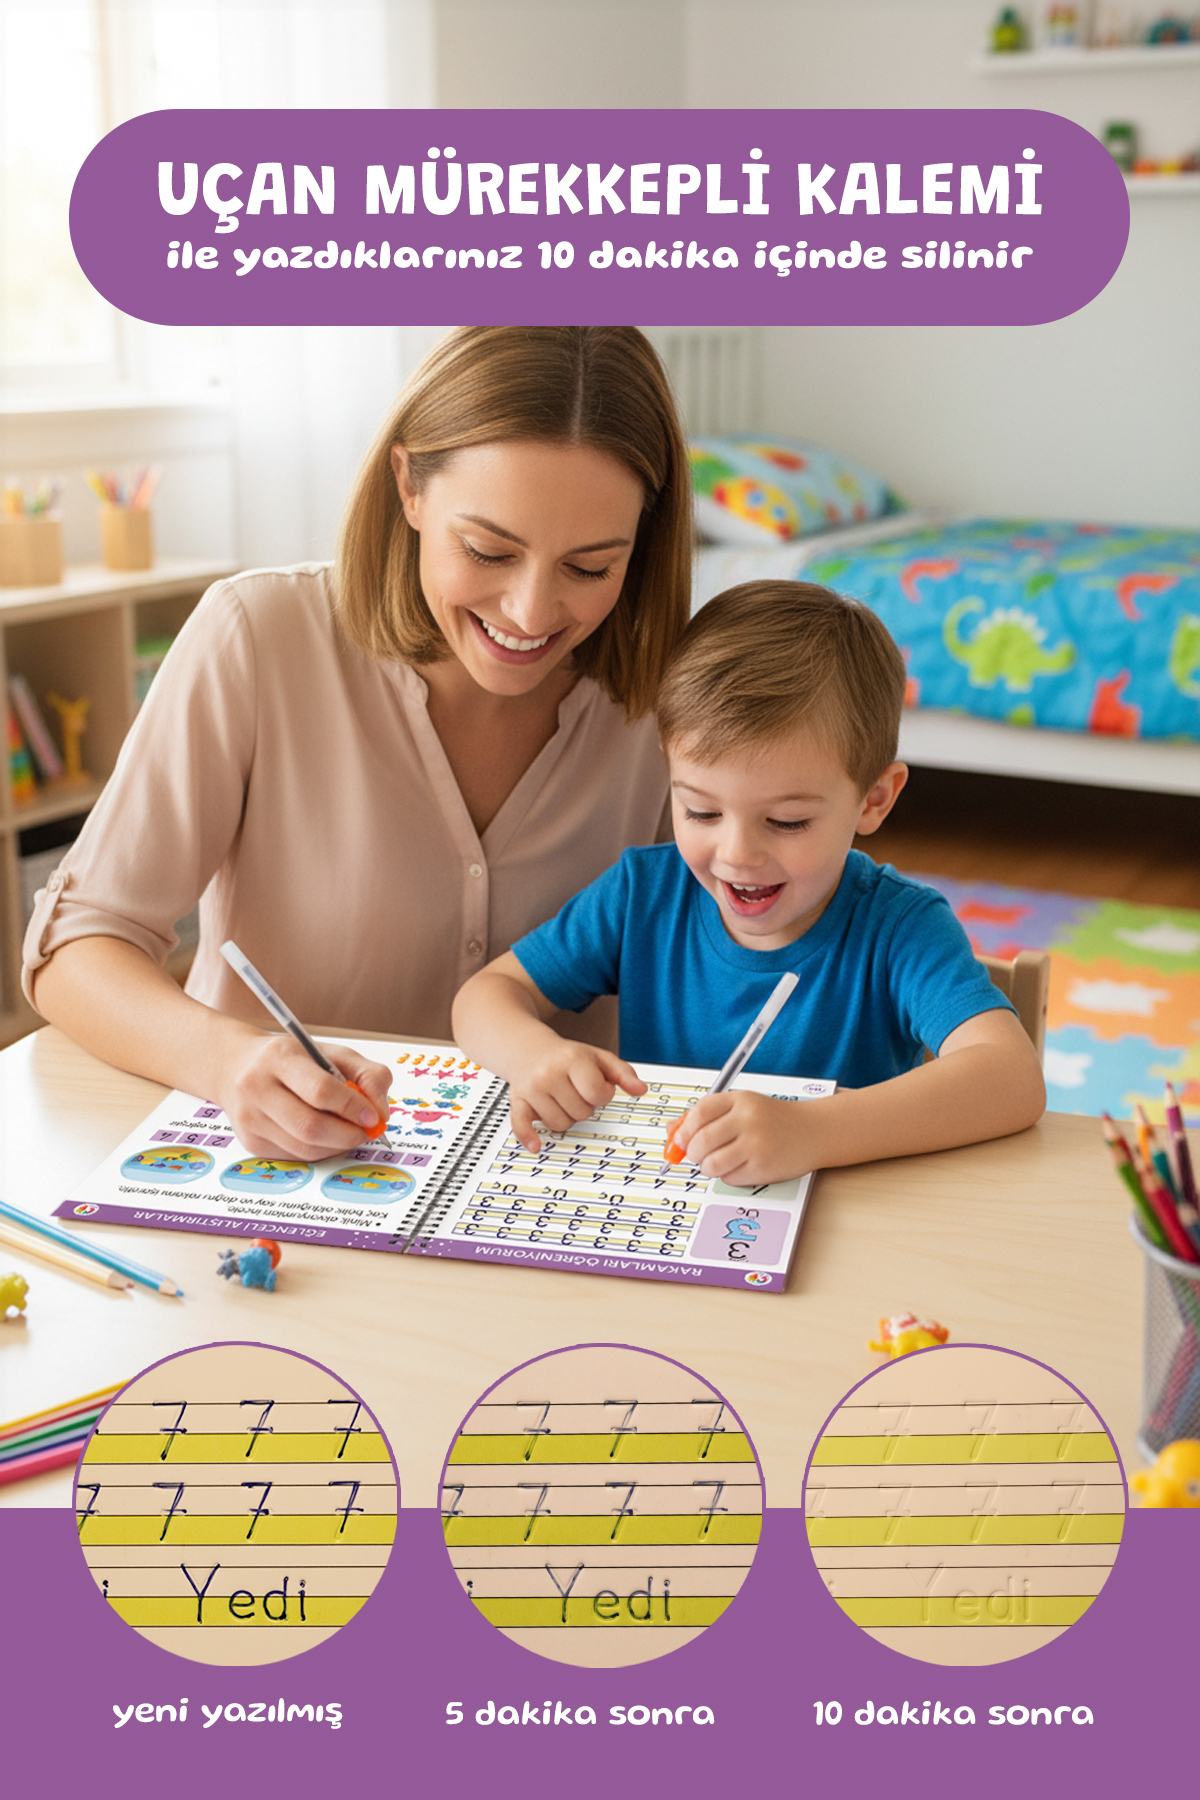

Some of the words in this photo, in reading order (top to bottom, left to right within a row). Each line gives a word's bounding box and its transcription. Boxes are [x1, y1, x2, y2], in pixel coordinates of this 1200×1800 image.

[201, 1108, 216, 1118] 5
[184, 1133, 198, 1143] 5
[212, 1136, 225, 1147] 2
[480, 1195, 495, 1208] 3
[511, 1198, 526, 1211] 3
[542, 1202, 558, 1214] 3
[472, 1209, 487, 1221] 3
[574, 1205, 589, 1217] 3
[606, 1208, 621, 1220] 3
[638, 1211, 653, 1223] 3
[133, 1211, 243, 1229] ALIŞTIRMALAR
[341, 1216, 373, 1227] Minik
[503, 1212, 519, 1224] 3
[535, 1215, 551, 1228] 3
[568, 1218, 583, 1231] 3
[670, 1214, 685, 1227] 3
[243, 1222, 327, 1238] EĞLENCELİ
[464, 1223, 479, 1236] 3
[496, 1226, 511, 1239] 3
[600, 1222, 615, 1234] 3
[632, 1225, 647, 1237] 3
[665, 1228, 680, 1241] 3
[722, 1218, 761, 1241] 3
[528, 1229, 544, 1242] 3
[561, 1232, 576, 1246] 3
[593, 1236, 609, 1249] 3
[626, 1239, 641, 1252] 3
[659, 1242, 674, 1255] 3
[475, 1246, 600, 1267] ÖĞRENİYORUM
[728, 1241, 750, 1259] 3
[603, 1258, 703, 1277] RAKAMLARI
[152, 1401, 187, 1461] 7
[240, 1400, 274, 1459] 7
[328, 1399, 361, 1459] 7
[517, 1401, 551, 1462] 7
[604, 1400, 638, 1460] 7
[692, 1399, 725, 1459] 7
[76, 1483, 101, 1537] 7
[152, 1482, 187, 1541] 7
[241, 1482, 273, 1540] 7
[328, 1481, 364, 1536] 7
[441, 1484, 464, 1534] 7
[518, 1483, 551, 1542] 7
[605, 1482, 638, 1541] 7
[692, 1481, 728, 1537] 7
[180, 1563, 306, 1624] Yedi
[545, 1563, 671, 1624] Yedi
[905, 1563, 1031, 1624] Yedi
